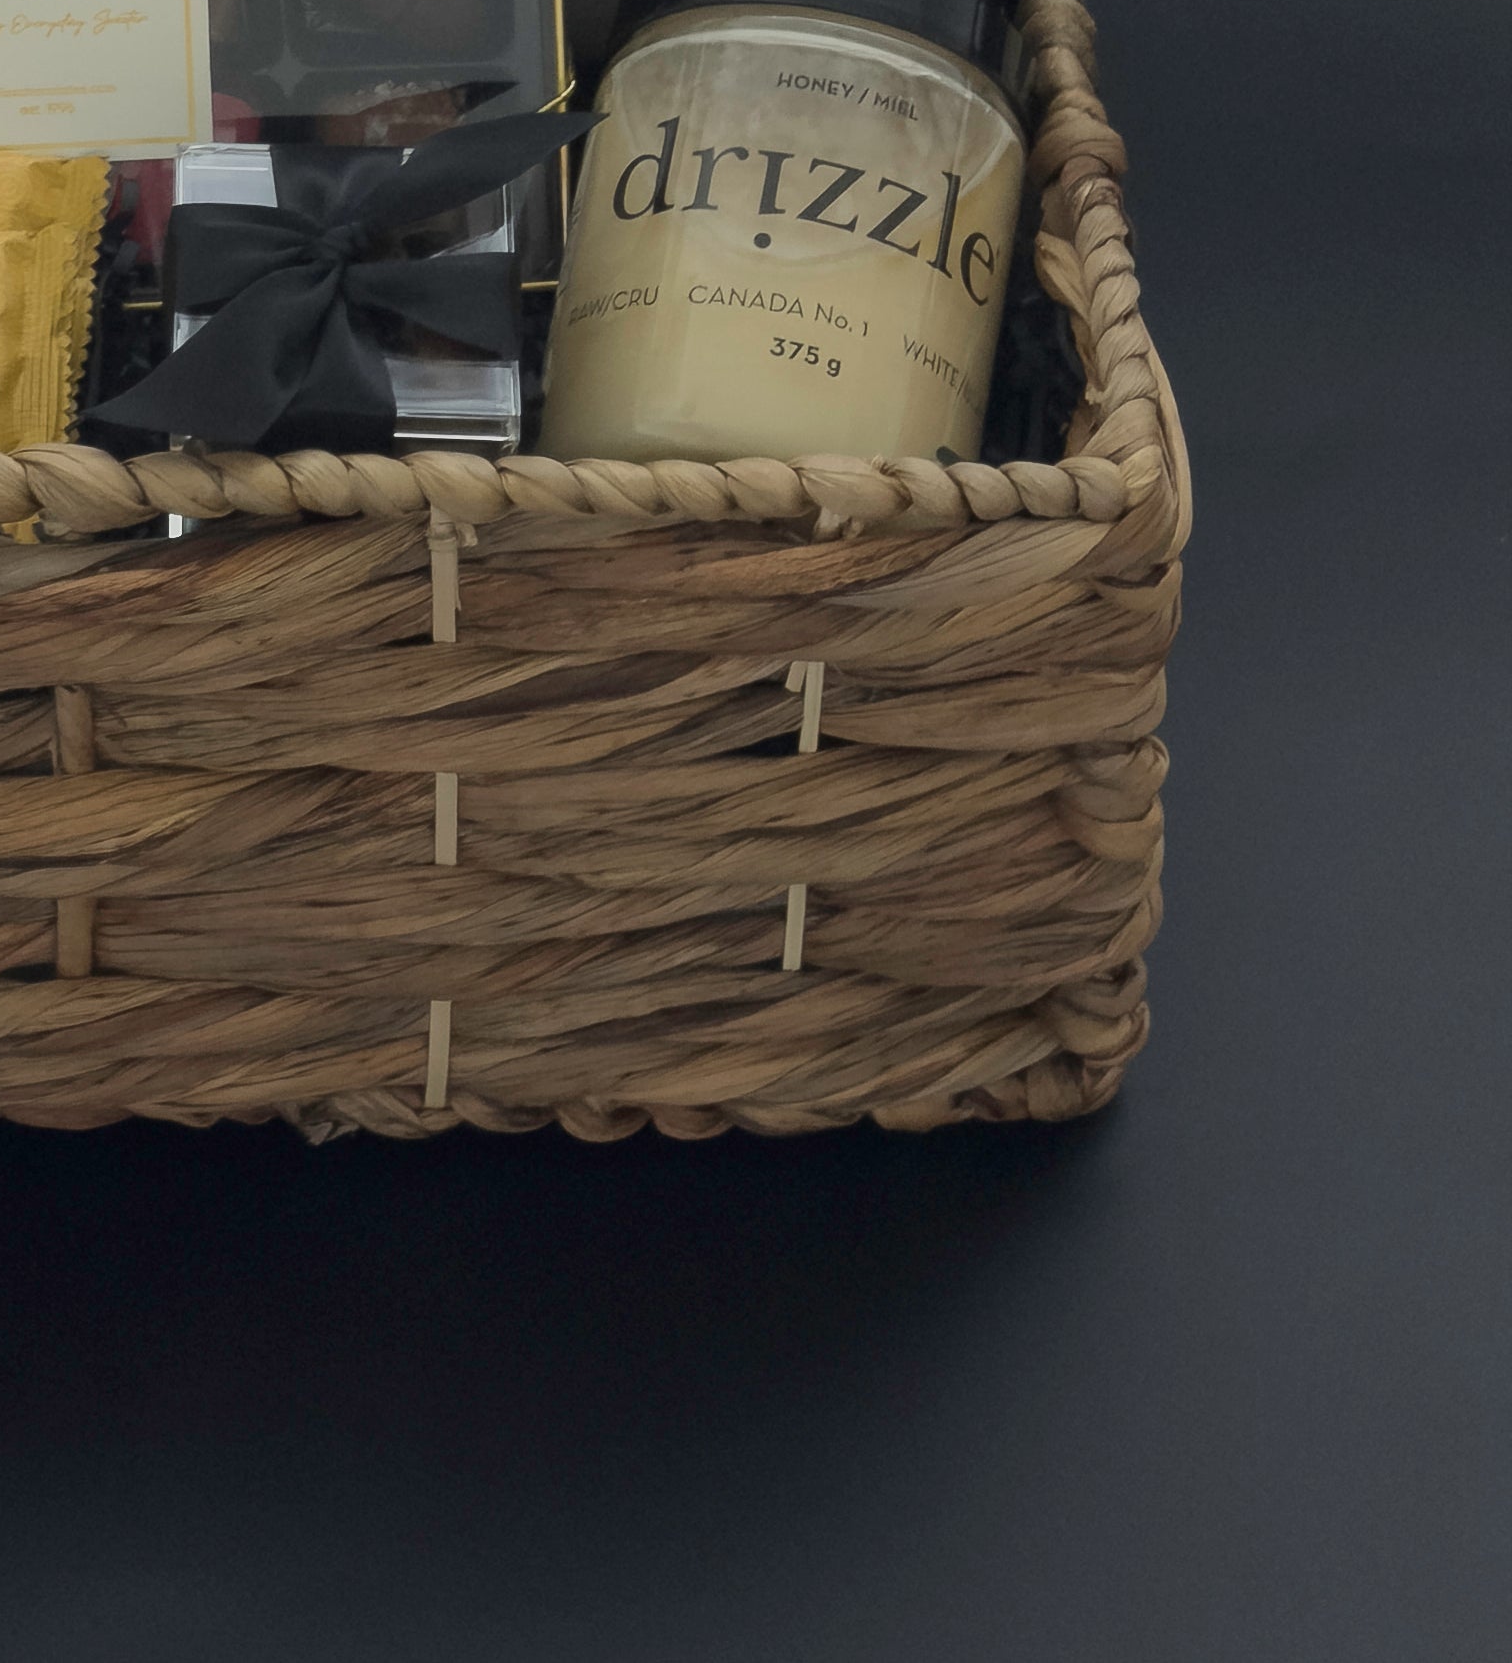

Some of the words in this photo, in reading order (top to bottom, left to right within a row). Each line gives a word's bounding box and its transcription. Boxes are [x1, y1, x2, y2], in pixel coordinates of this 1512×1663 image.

[777, 72, 854, 99] HONEY
[873, 92, 919, 121] MIEL
[612, 115, 997, 307] drizzle
[688, 285, 804, 318] CANADA
[814, 303, 853, 333] No.
[769, 337, 820, 365] 375
[826, 358, 841, 377] g
